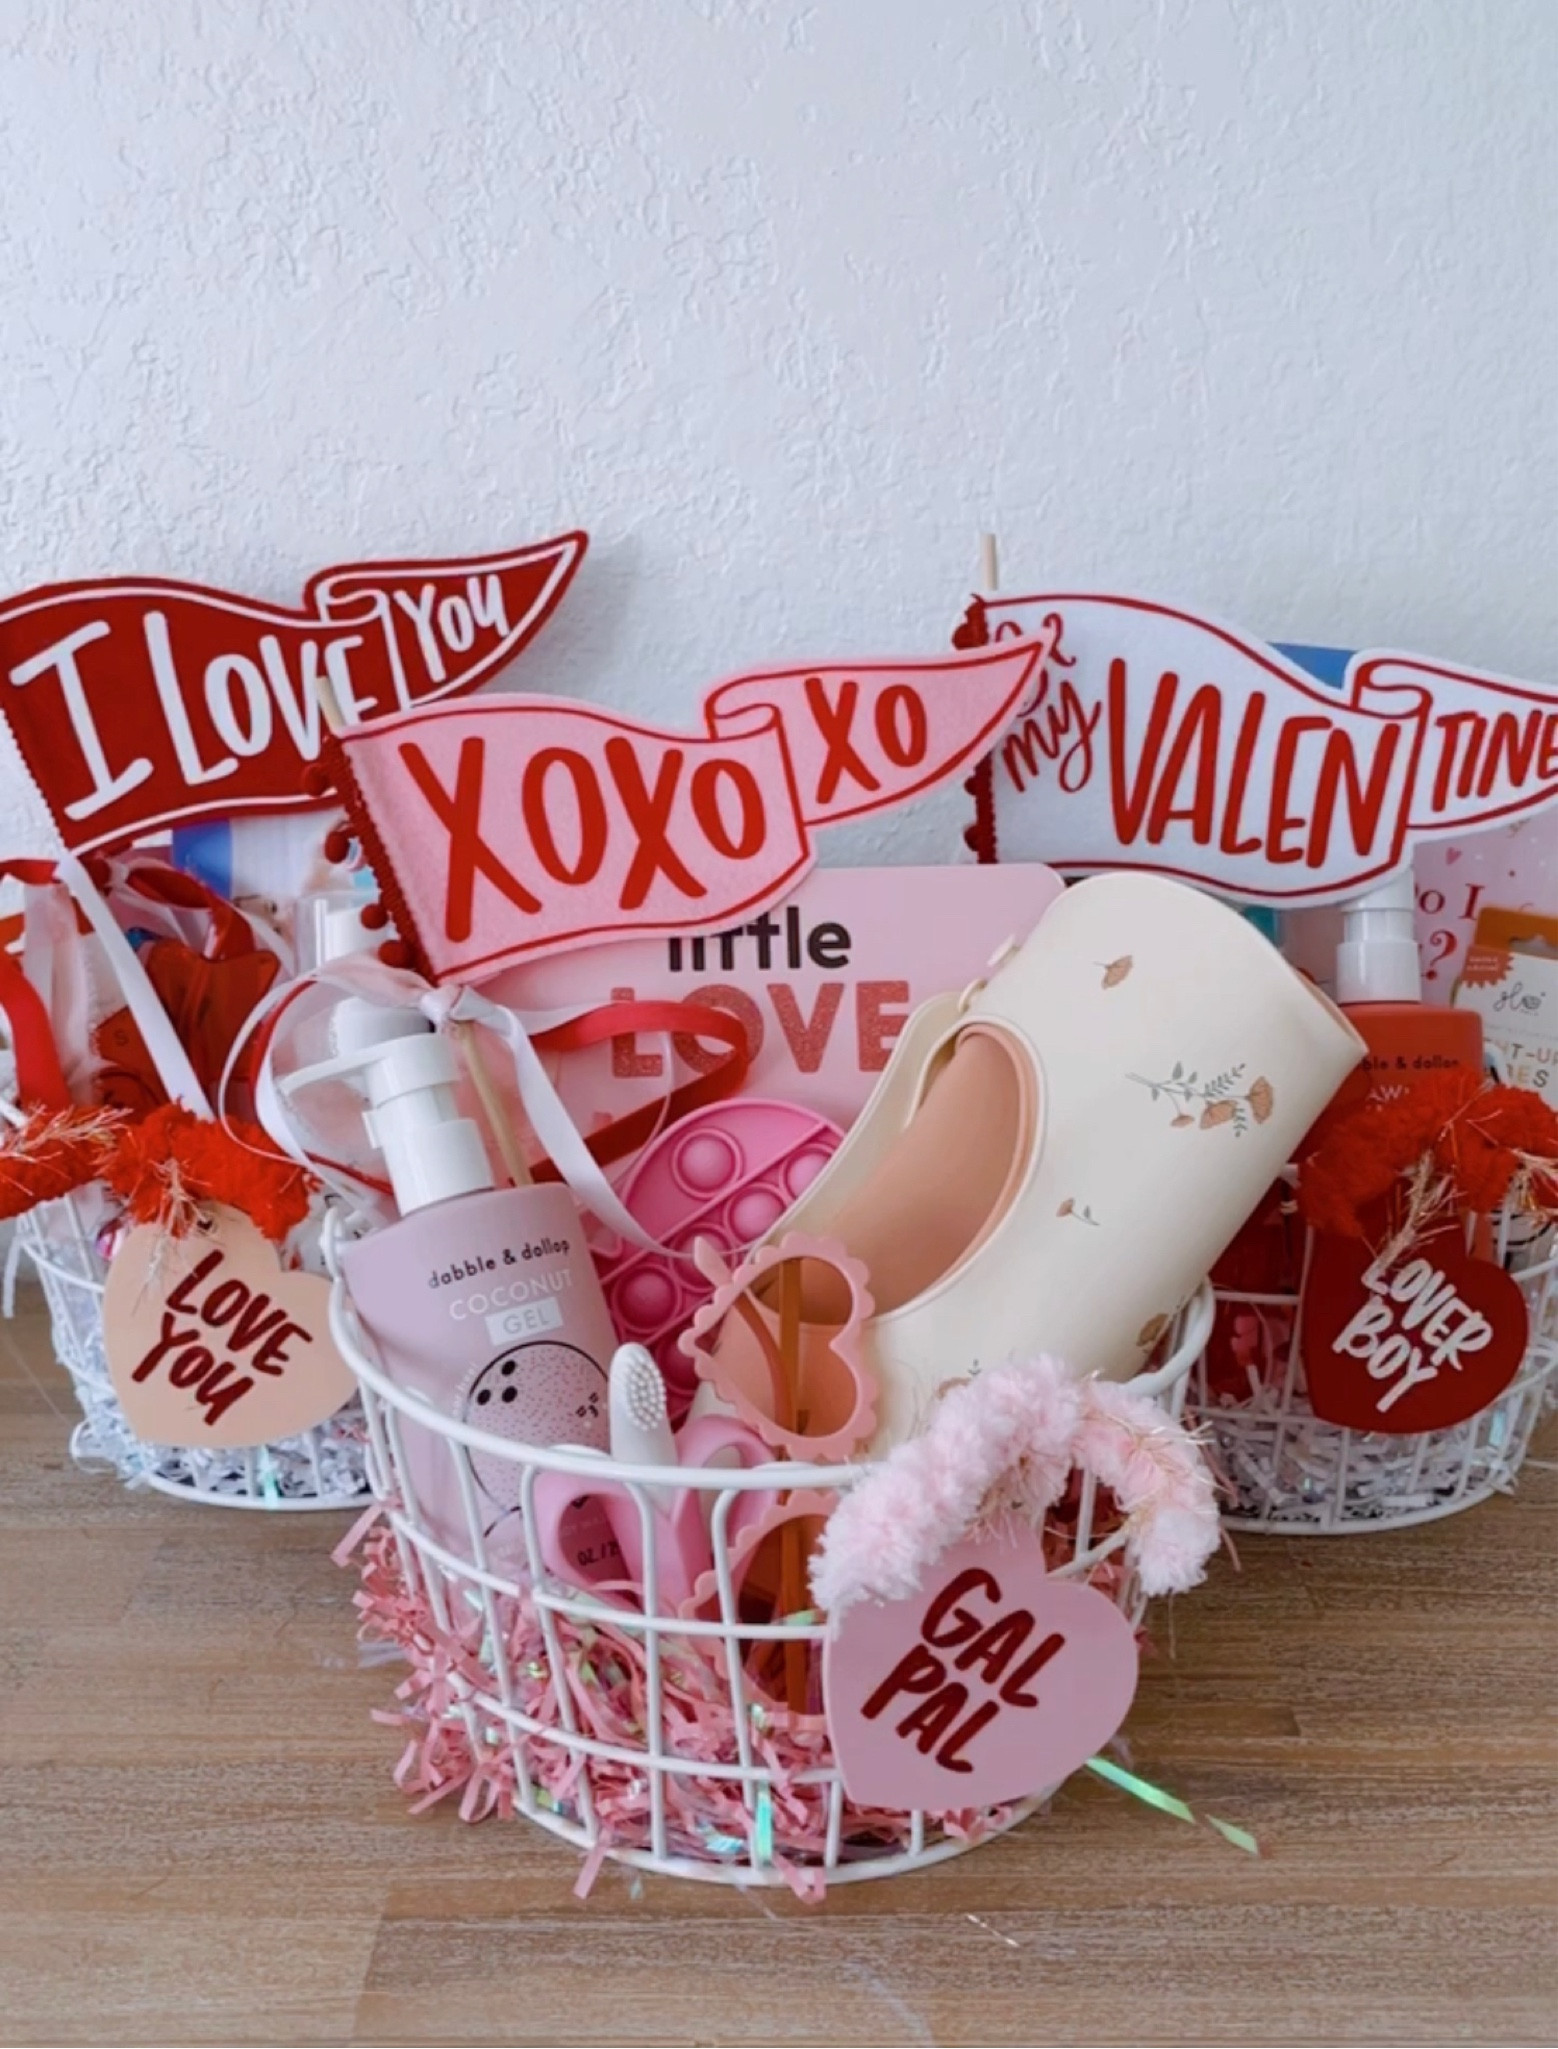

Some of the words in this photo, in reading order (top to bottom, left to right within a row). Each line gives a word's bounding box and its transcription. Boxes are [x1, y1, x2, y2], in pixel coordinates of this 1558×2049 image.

[10, 621, 153, 820] I
[143, 611, 378, 785] LOVE
[1003, 680, 1101, 793] my
[1108, 658, 1400, 868] VALEN
[399, 736, 767, 943] XOXO
[804, 677, 927, 804] XO
[611, 980, 910, 1079] LOVE
[166, 1249, 312, 1376] LOVE
[428, 1256, 496, 1289] dabble
[502, 1248, 517, 1266] &
[521, 1237, 570, 1260] dollop
[450, 1268, 574, 1320] COCONUT
[503, 1308, 550, 1334] GEL
[1361, 1257, 1493, 1371] LOVER
[131, 1312, 254, 1426] YOU
[1332, 1295, 1438, 1413] BOY
[921, 1568, 1065, 1708] GAL
[860, 1643, 1000, 1772] PAL
